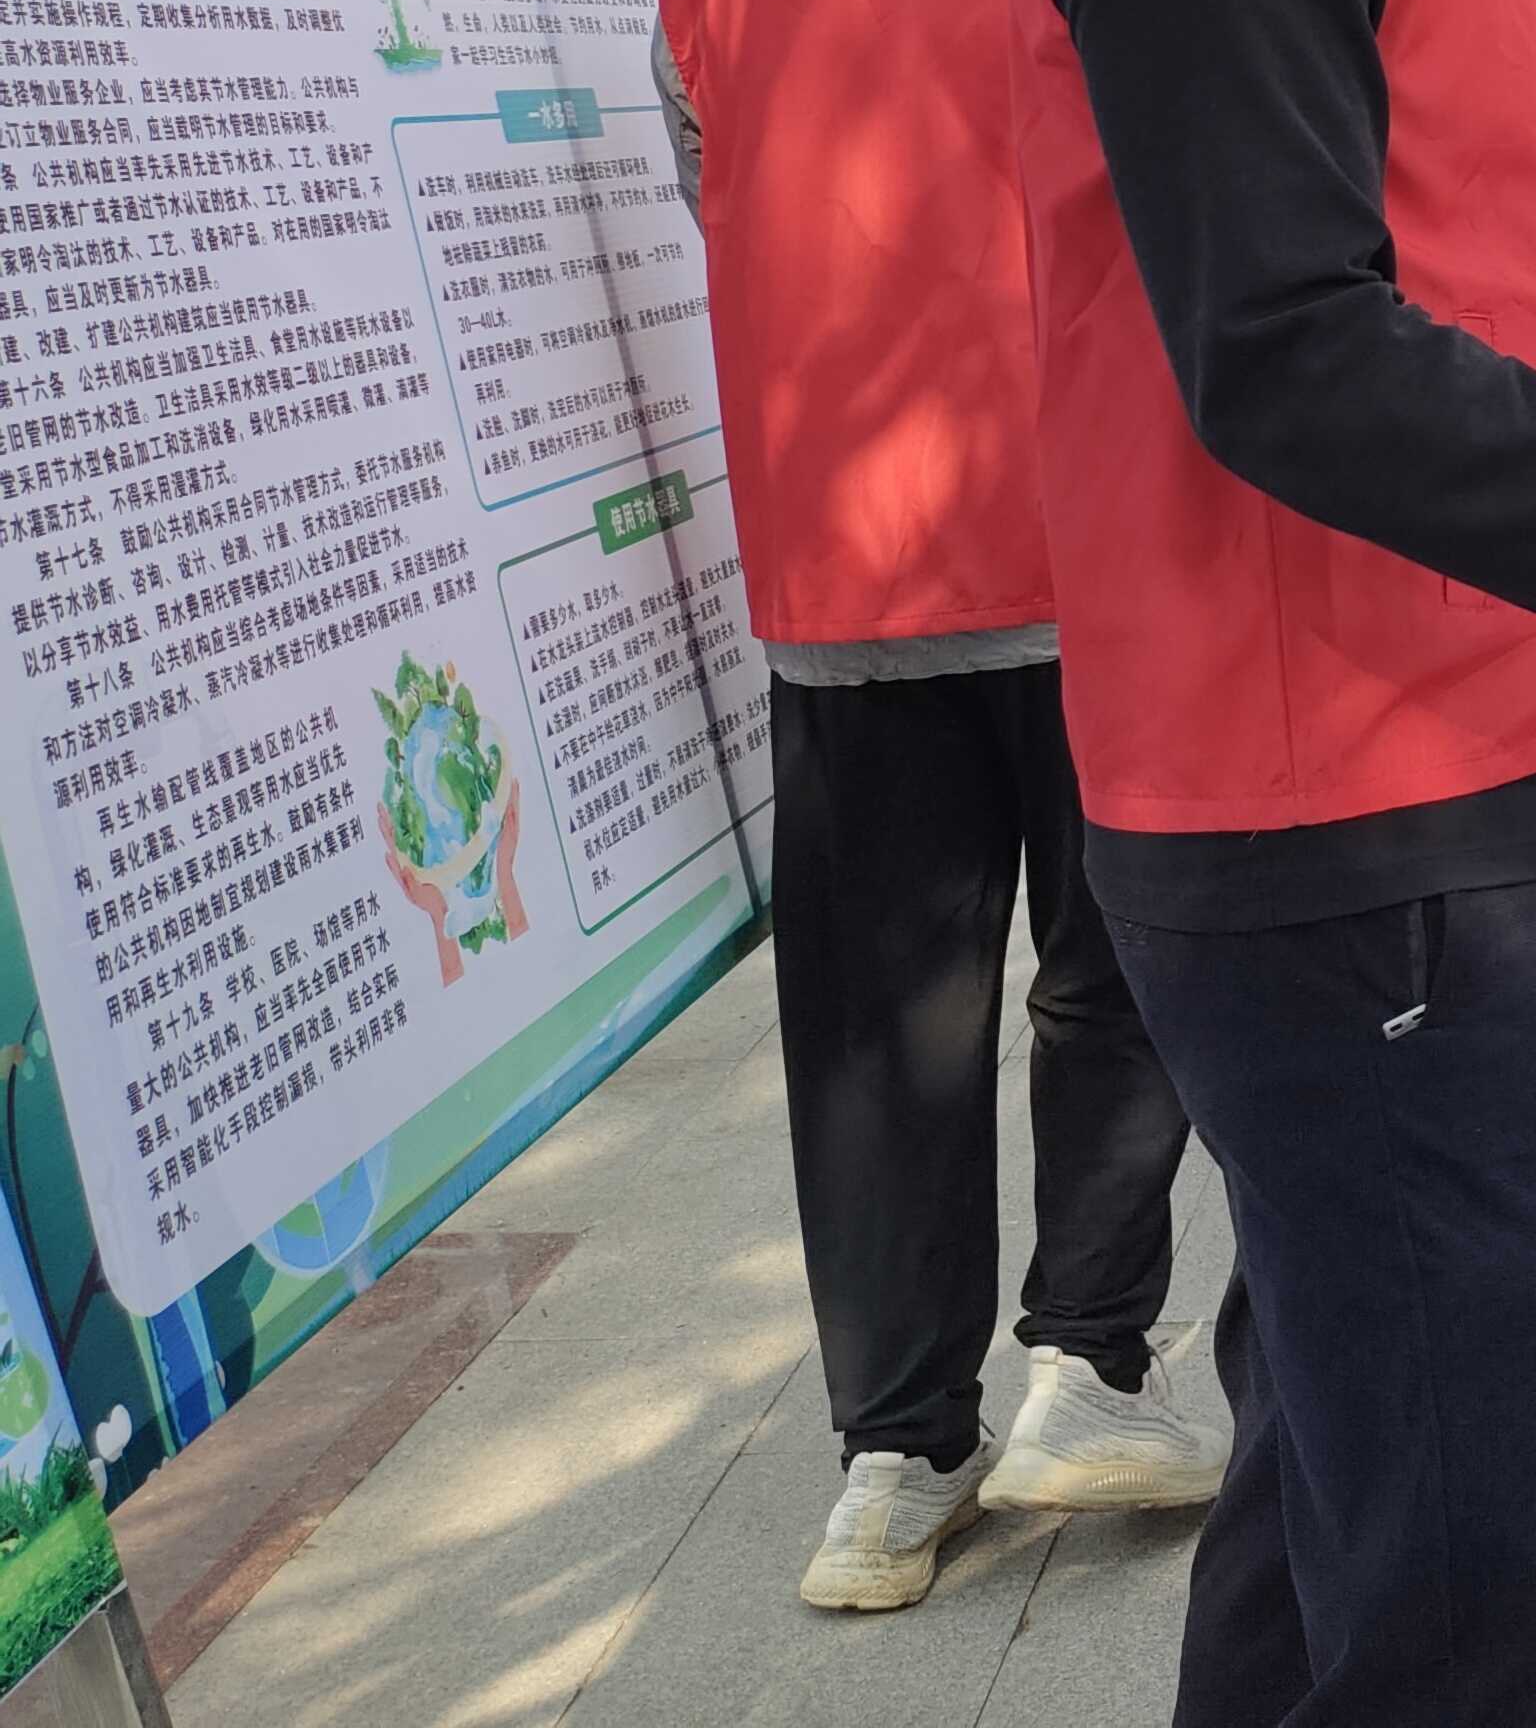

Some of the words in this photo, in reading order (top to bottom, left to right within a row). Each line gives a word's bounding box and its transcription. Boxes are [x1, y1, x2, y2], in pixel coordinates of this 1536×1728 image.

[528, 100, 578, 129] 一水多用
[0, 208, 391, 276] 家明令淘汰的技术、工艺、设备和产品。对在用的国家明令淘汰
[0, 289, 317, 367] 建、改建、扩建公共机构建筑应当使用节水器具。
[0, 371, 67, 409] 第十六条
[610, 485, 681, 537] 使用节水器具
[34, 537, 105, 581] 第十七条
[66, 661, 135, 709] 第十八条
[96, 706, 338, 837] 再生水输配管线覆盖地区的公共机
[96, 815, 365, 984] 的公共机构因地制宜规划建设雨水集蓄利
[147, 992, 215, 1051] 第十九条
